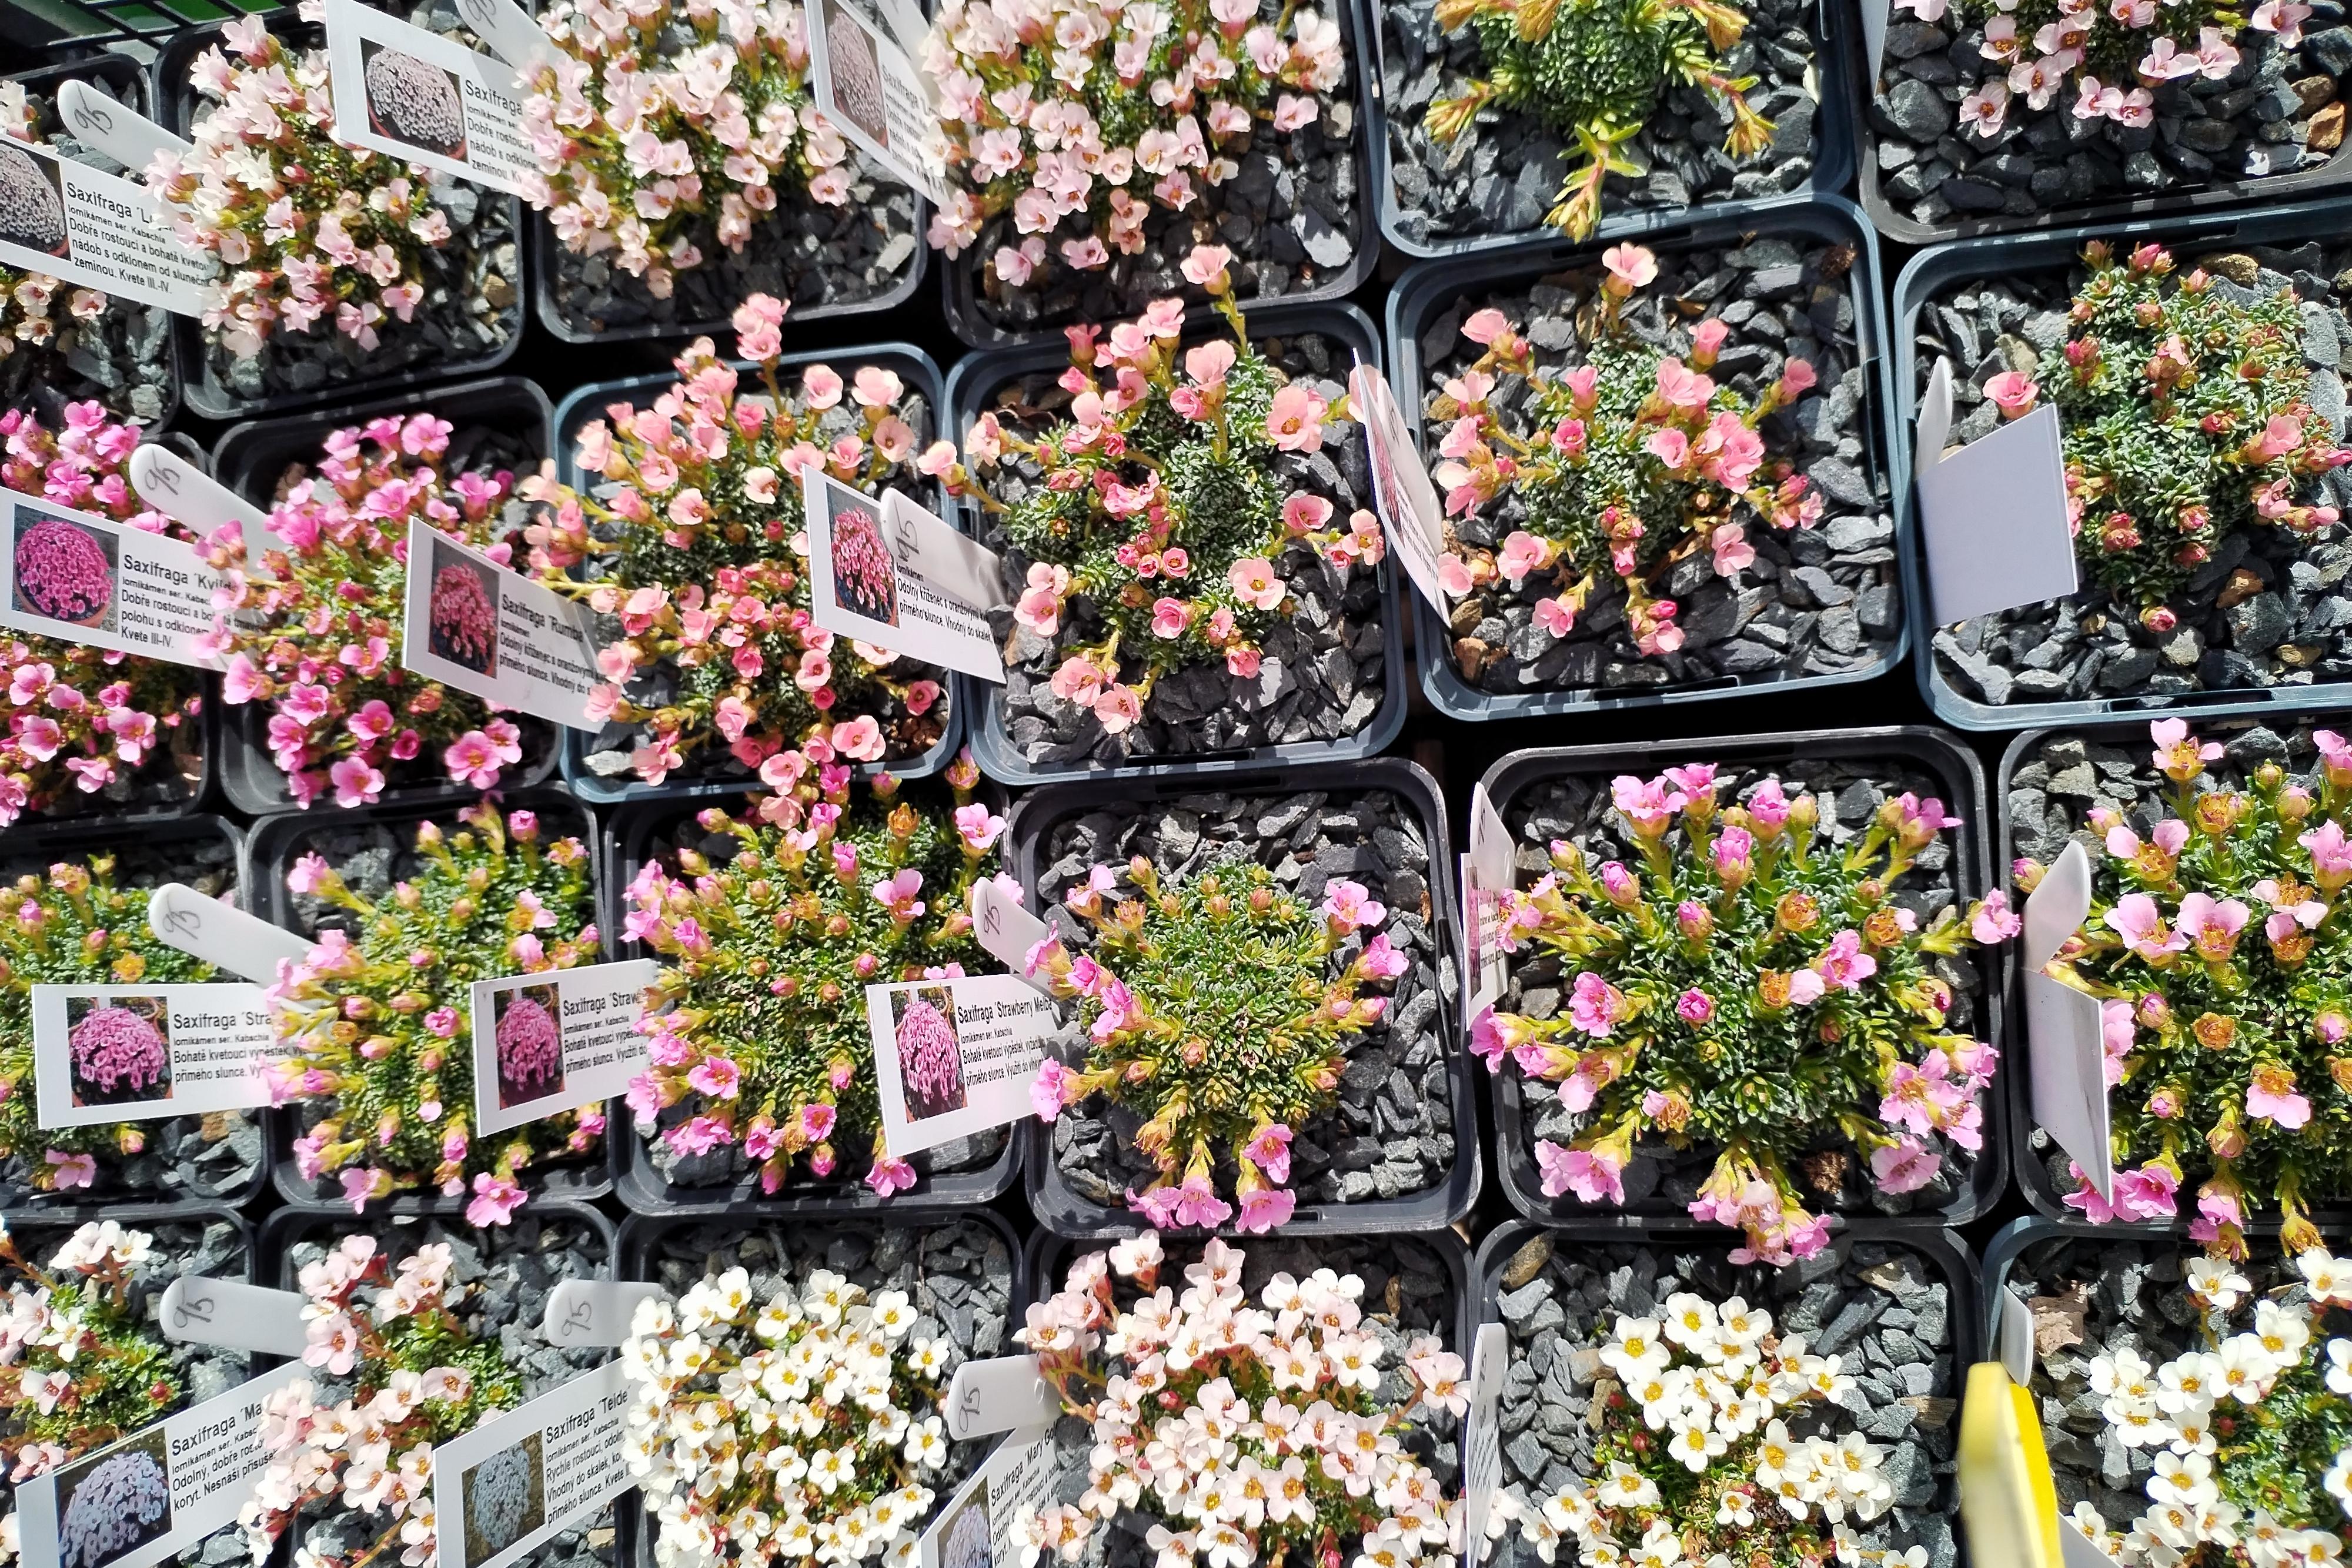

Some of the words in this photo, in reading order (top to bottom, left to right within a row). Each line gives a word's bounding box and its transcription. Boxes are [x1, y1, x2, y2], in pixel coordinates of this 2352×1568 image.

[74, 81, 112, 136] 95
[465, 79, 523, 116] Saxifraga
[66, 182, 132, 218] Saxifraga
[68, 204, 112, 226] lomikámen
[131, 226, 166, 244] Kabschia
[69, 217, 98, 238] Dobře
[141, 243, 146, 253] a
[149, 243, 179, 263] bohatě
[72, 238, 102, 256] nádob
[104, 249, 110, 259] s
[112, 250, 156, 273] odklonem
[159, 266, 170, 277] od
[74, 256, 117, 278] zeminou.
[119, 267, 145, 286] Kvete
[145, 447, 181, 496] 95
[894, 499, 920, 562] 95
[123, 554, 189, 586] Saxifraga
[121, 589, 150, 604] Dobře
[898, 577, 918, 601] Odolný
[121, 610, 154, 627] polohu
[156, 618, 162, 627] s
[502, 593, 546, 628] Saxifraga
[900, 599, 924, 620] přímého
[945, 615, 966, 637] Vhodný
[121, 626, 148, 643] Kvete
[983, 888, 1000, 935] 95
[173, 1012, 236, 1030] Saxifraga
[563, 997, 606, 1017] Saxifraga
[957, 1004, 994, 1025] Saxifraga
[173, 1036, 216, 1046] lomikámen
[174, 1048, 206, 1064] Bohatě
[962, 1045, 982, 1065] Bohatě
[175, 1068, 213, 1085] přímého
[965, 1069, 988, 1091] přímého
[173, 1284, 214, 1328] 95
[562, 1295, 592, 1336] 95
[959, 1375, 980, 1433] 95
[172, 1416, 236, 1456] Saxifraga
[546, 1407, 595, 1444] Saxifraga
[172, 1447, 216, 1475] lomikámen
[218, 1440, 232, 1452] ser.
[235, 1426, 258, 1444] Kabsc
[212, 1450, 238, 1472] dobře
[546, 1437, 580, 1464] lomikámen
[203, 1468, 240, 1496] Nesnáší
[546, 1459, 571, 1484] Rychle
[547, 1475, 574, 1503] Vhodný
[576, 1471, 586, 1487] do
[991, 1460, 1023, 1507] Saxifraga
[547, 1499, 577, 1528] přímého
[605, 1467, 624, 1487] Kvete
